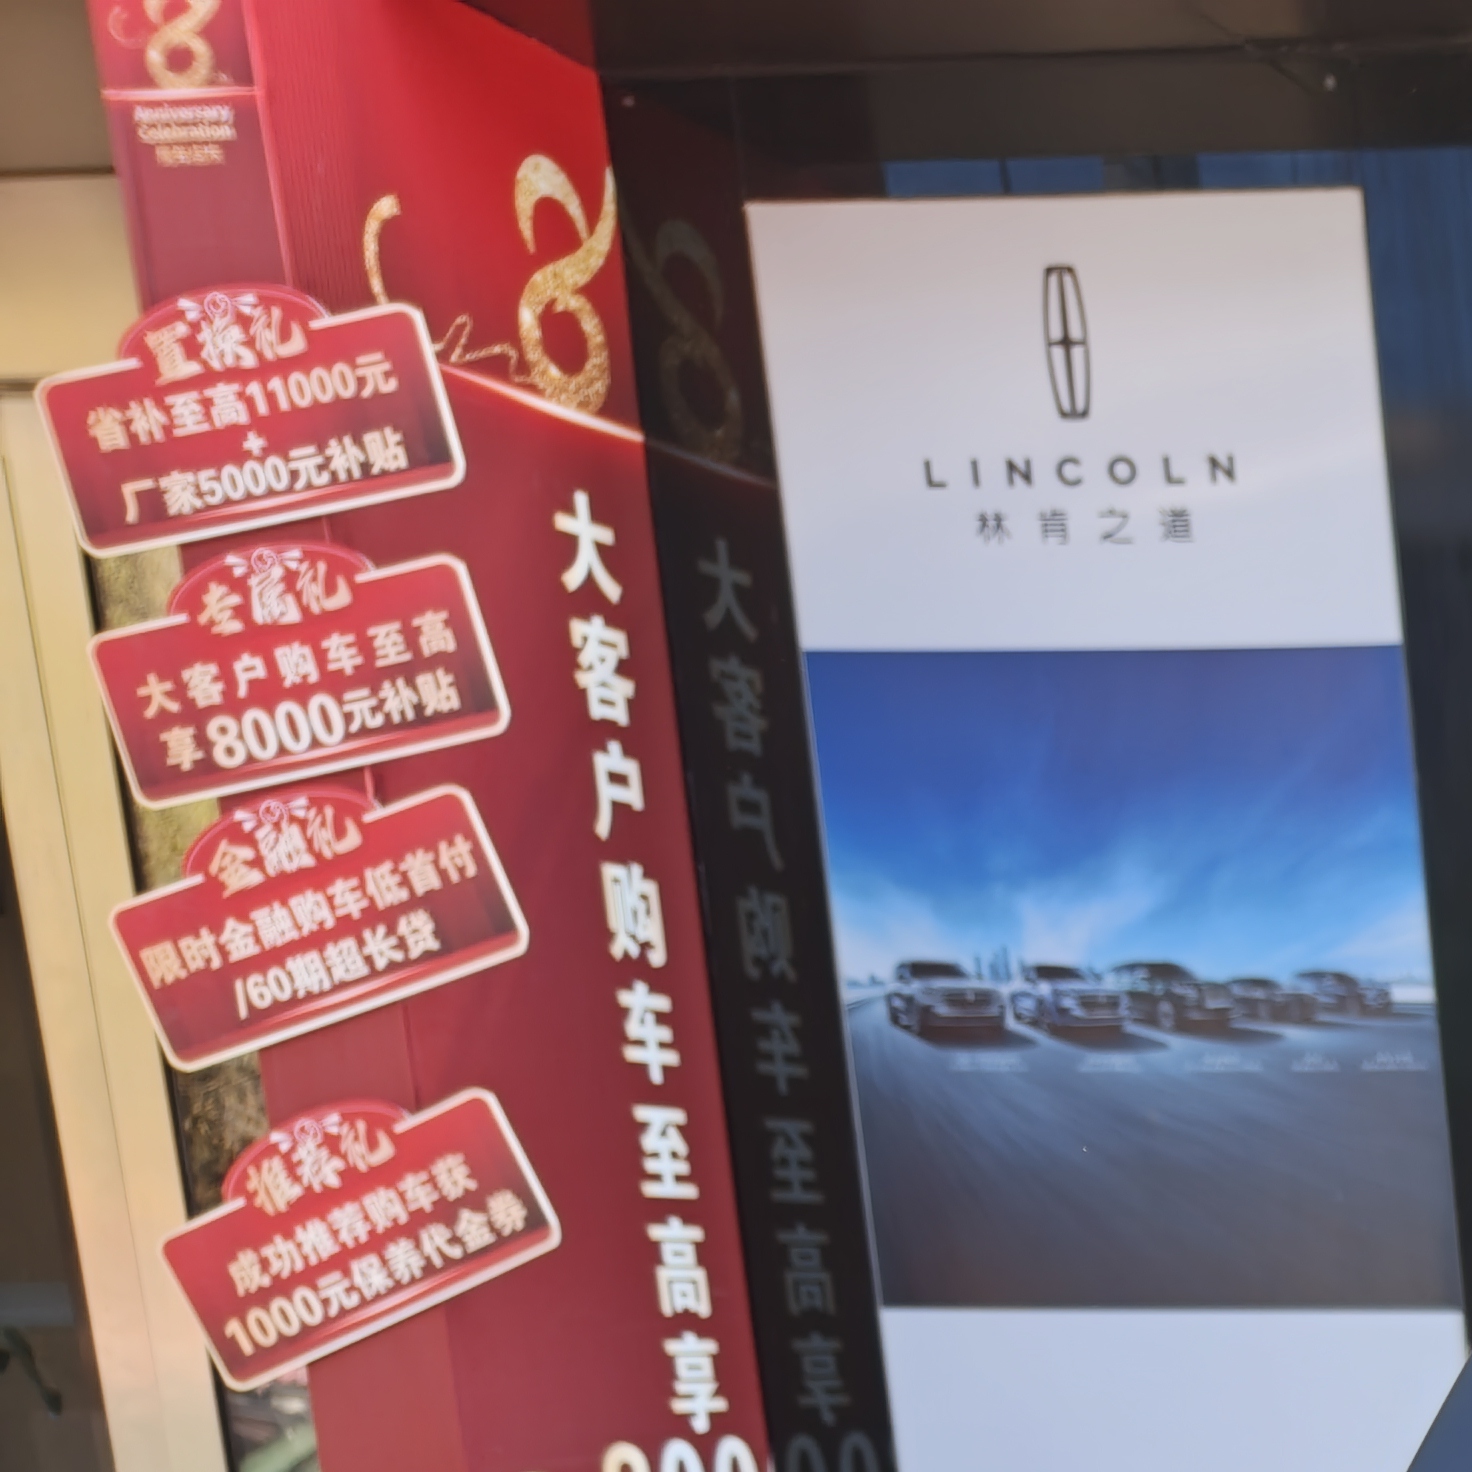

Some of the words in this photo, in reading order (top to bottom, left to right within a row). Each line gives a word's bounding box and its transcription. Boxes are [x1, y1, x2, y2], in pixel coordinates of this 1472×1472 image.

[134, 104, 235, 125] Anniversary
[137, 122, 237, 144] Celebration
[145, 305, 308, 386] 置换礼
[87, 351, 399, 453] 省补至高11000元
[120, 426, 409, 525] 厂家5000元补贴
[922, 453, 1240, 490] LINCOLN
[975, 506, 1197, 546] 林肯之道
[198, 559, 353, 636] 专属礼
[136, 608, 458, 720] 大客户购车至高
[160, 666, 462, 773] 享8000元补贴
[208, 804, 364, 899] 金融礼
[138, 833, 479, 990] 限时金融购车低首付
[246, 1118, 396, 1217] 推荐礼
[224, 1188, 529, 1357] 1000元保养代金券
[226, 1151, 479, 1298] 成功推荐购车获
